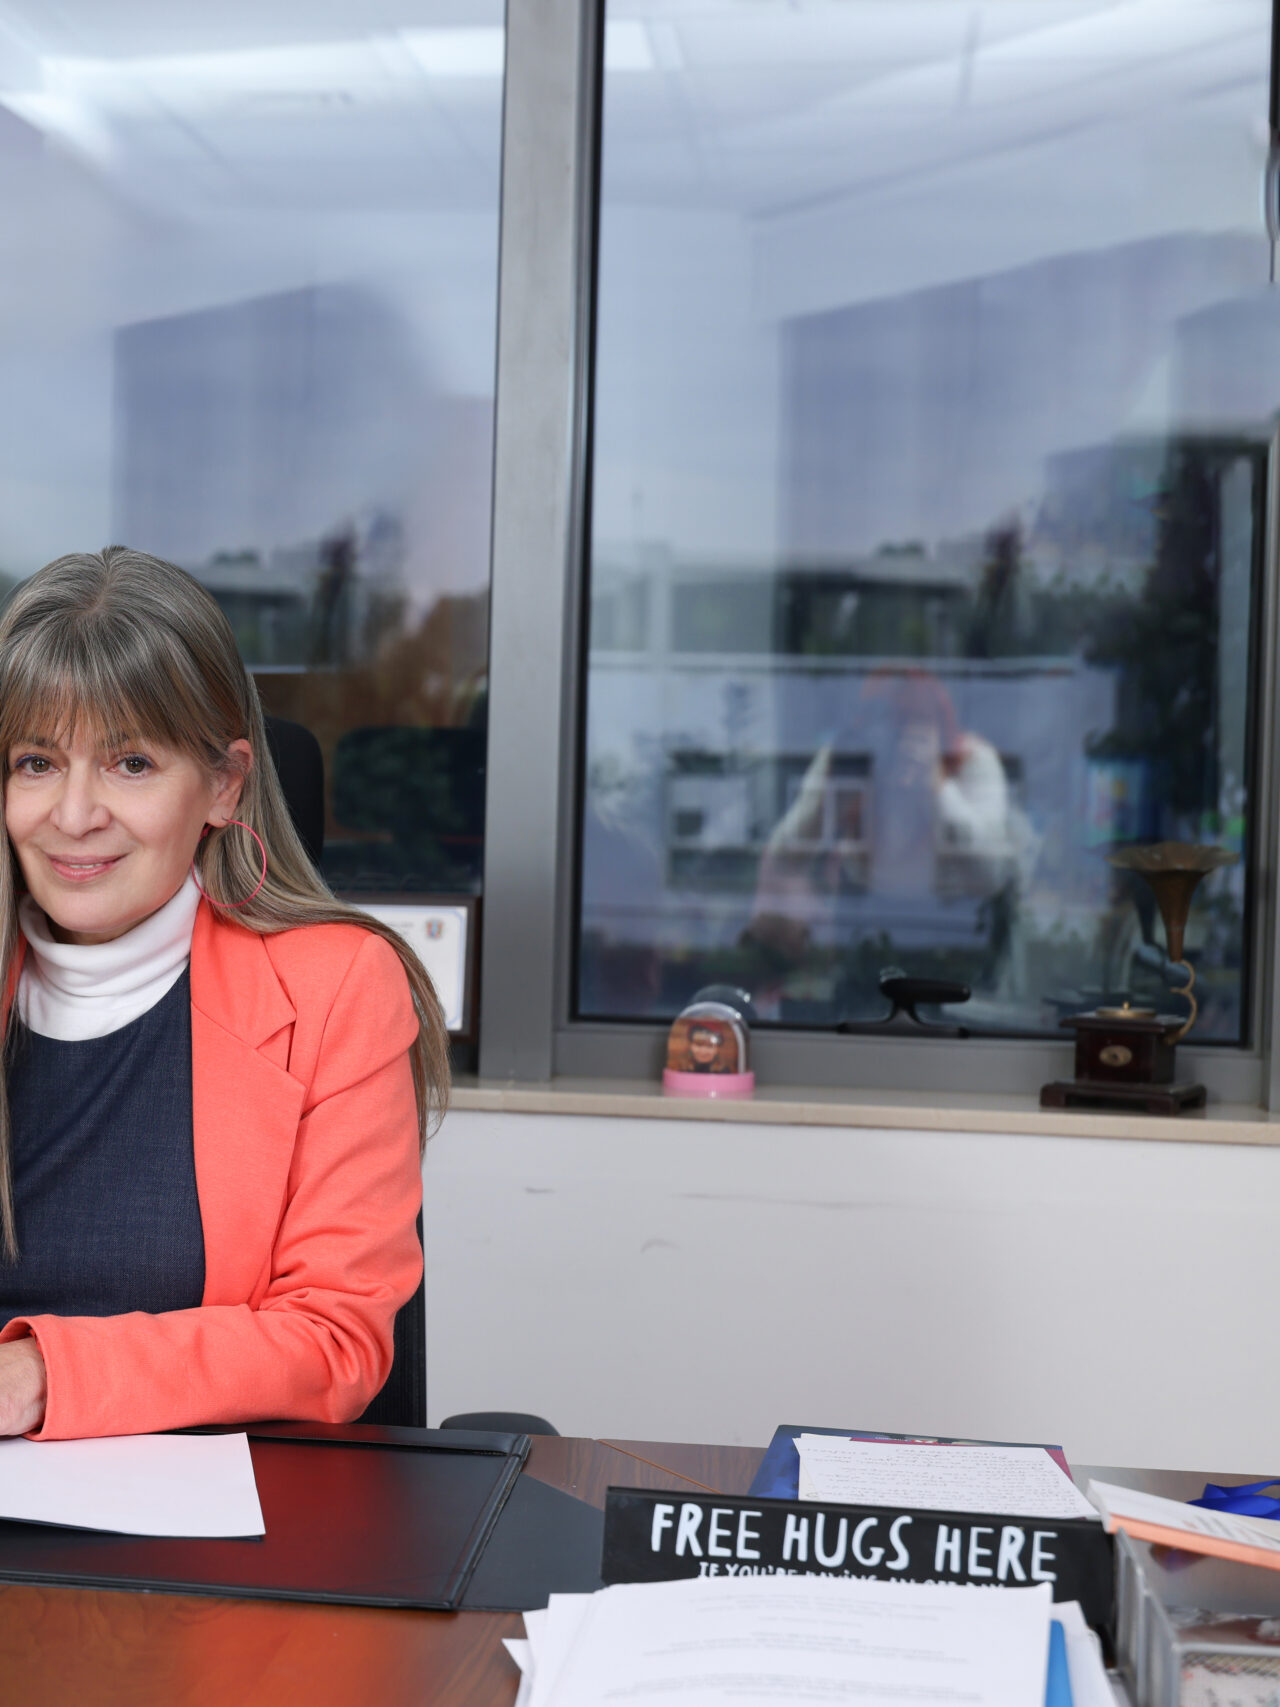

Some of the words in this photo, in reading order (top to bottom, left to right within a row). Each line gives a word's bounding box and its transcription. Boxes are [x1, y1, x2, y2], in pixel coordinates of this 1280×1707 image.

[651, 1503, 762, 1560] FREE
[782, 1513, 913, 1571] HUGS
[934, 1524, 1058, 1581] HERE
[698, 1561, 720, 1579] IF
